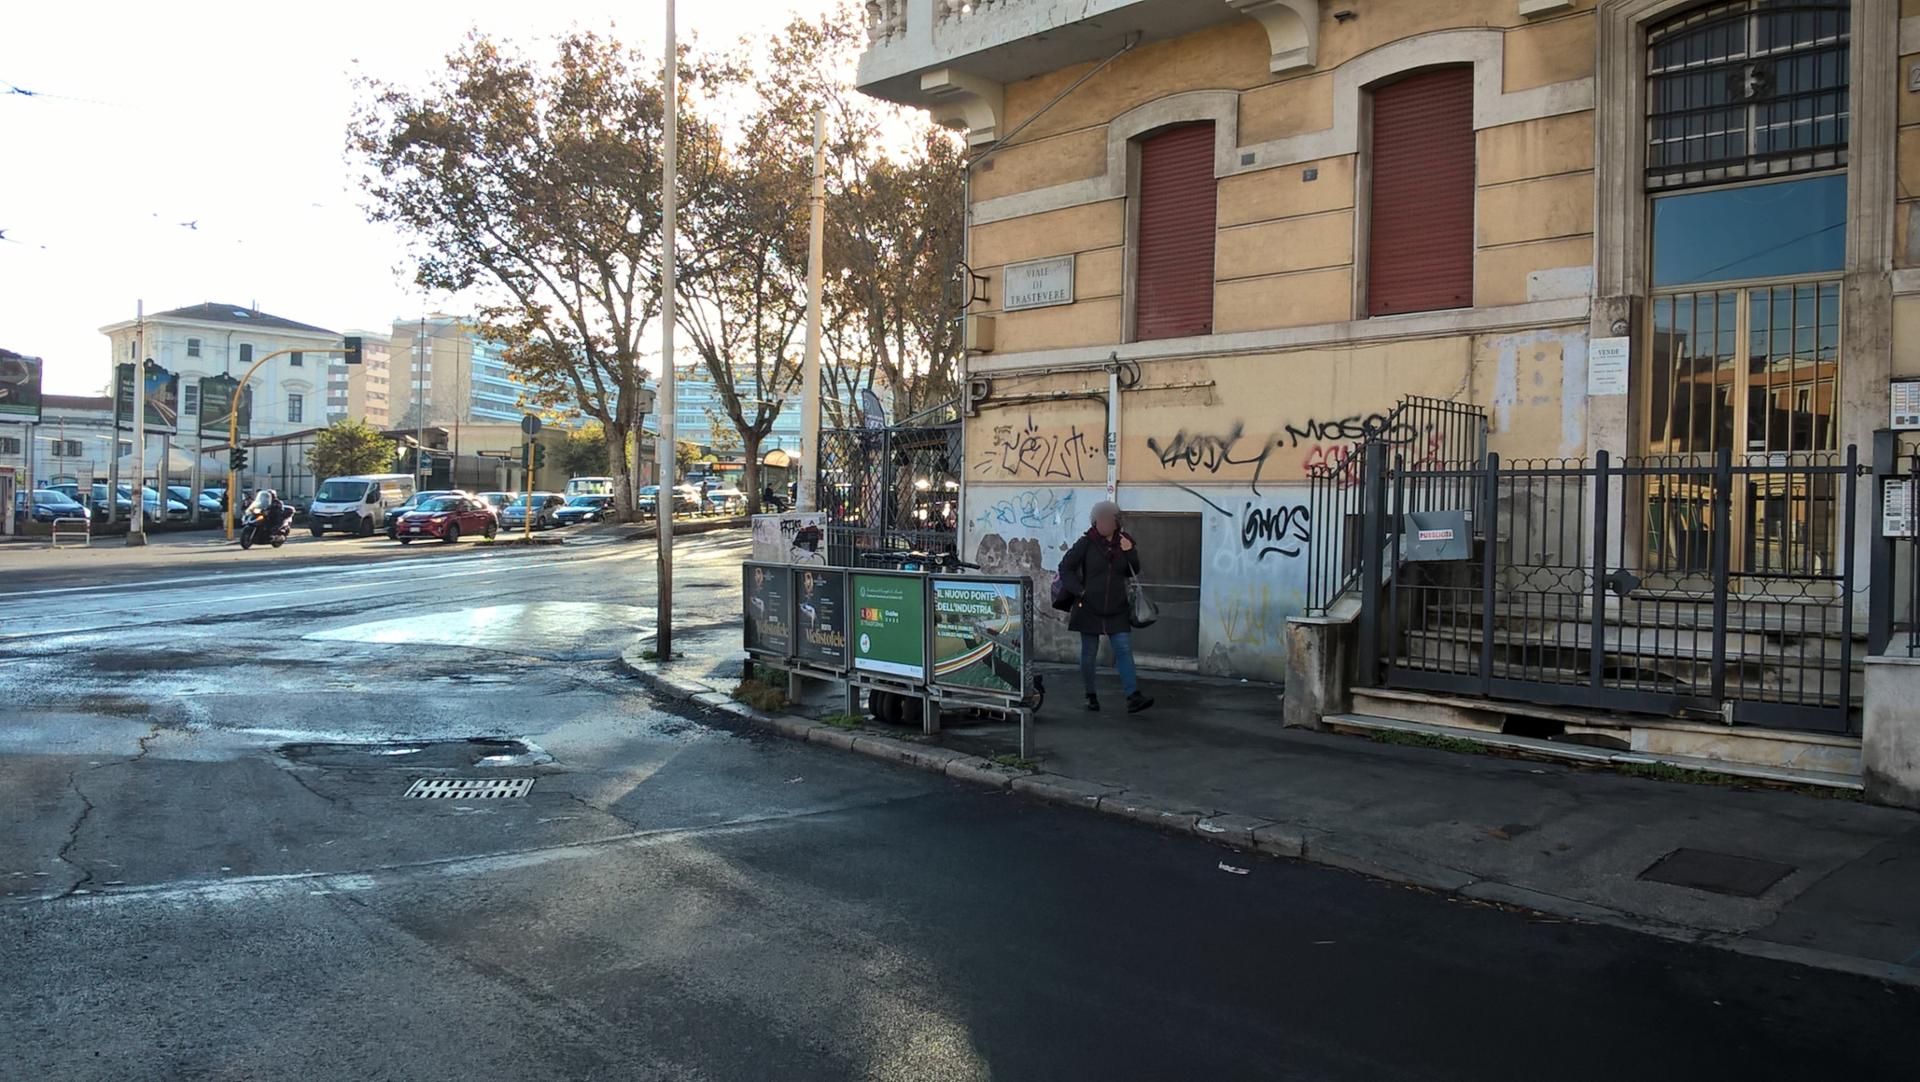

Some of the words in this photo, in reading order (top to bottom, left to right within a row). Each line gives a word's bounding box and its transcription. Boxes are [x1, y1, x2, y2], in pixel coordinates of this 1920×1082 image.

[1026, 267, 1049, 278] VIALE
[1033, 279, 1043, 290] DI
[1010, 289, 1065, 305] TRASTEVERE
[937, 589, 944, 598] IL
[945, 590, 970, 600] NUOVO
[970, 591, 995, 601] PONTE
